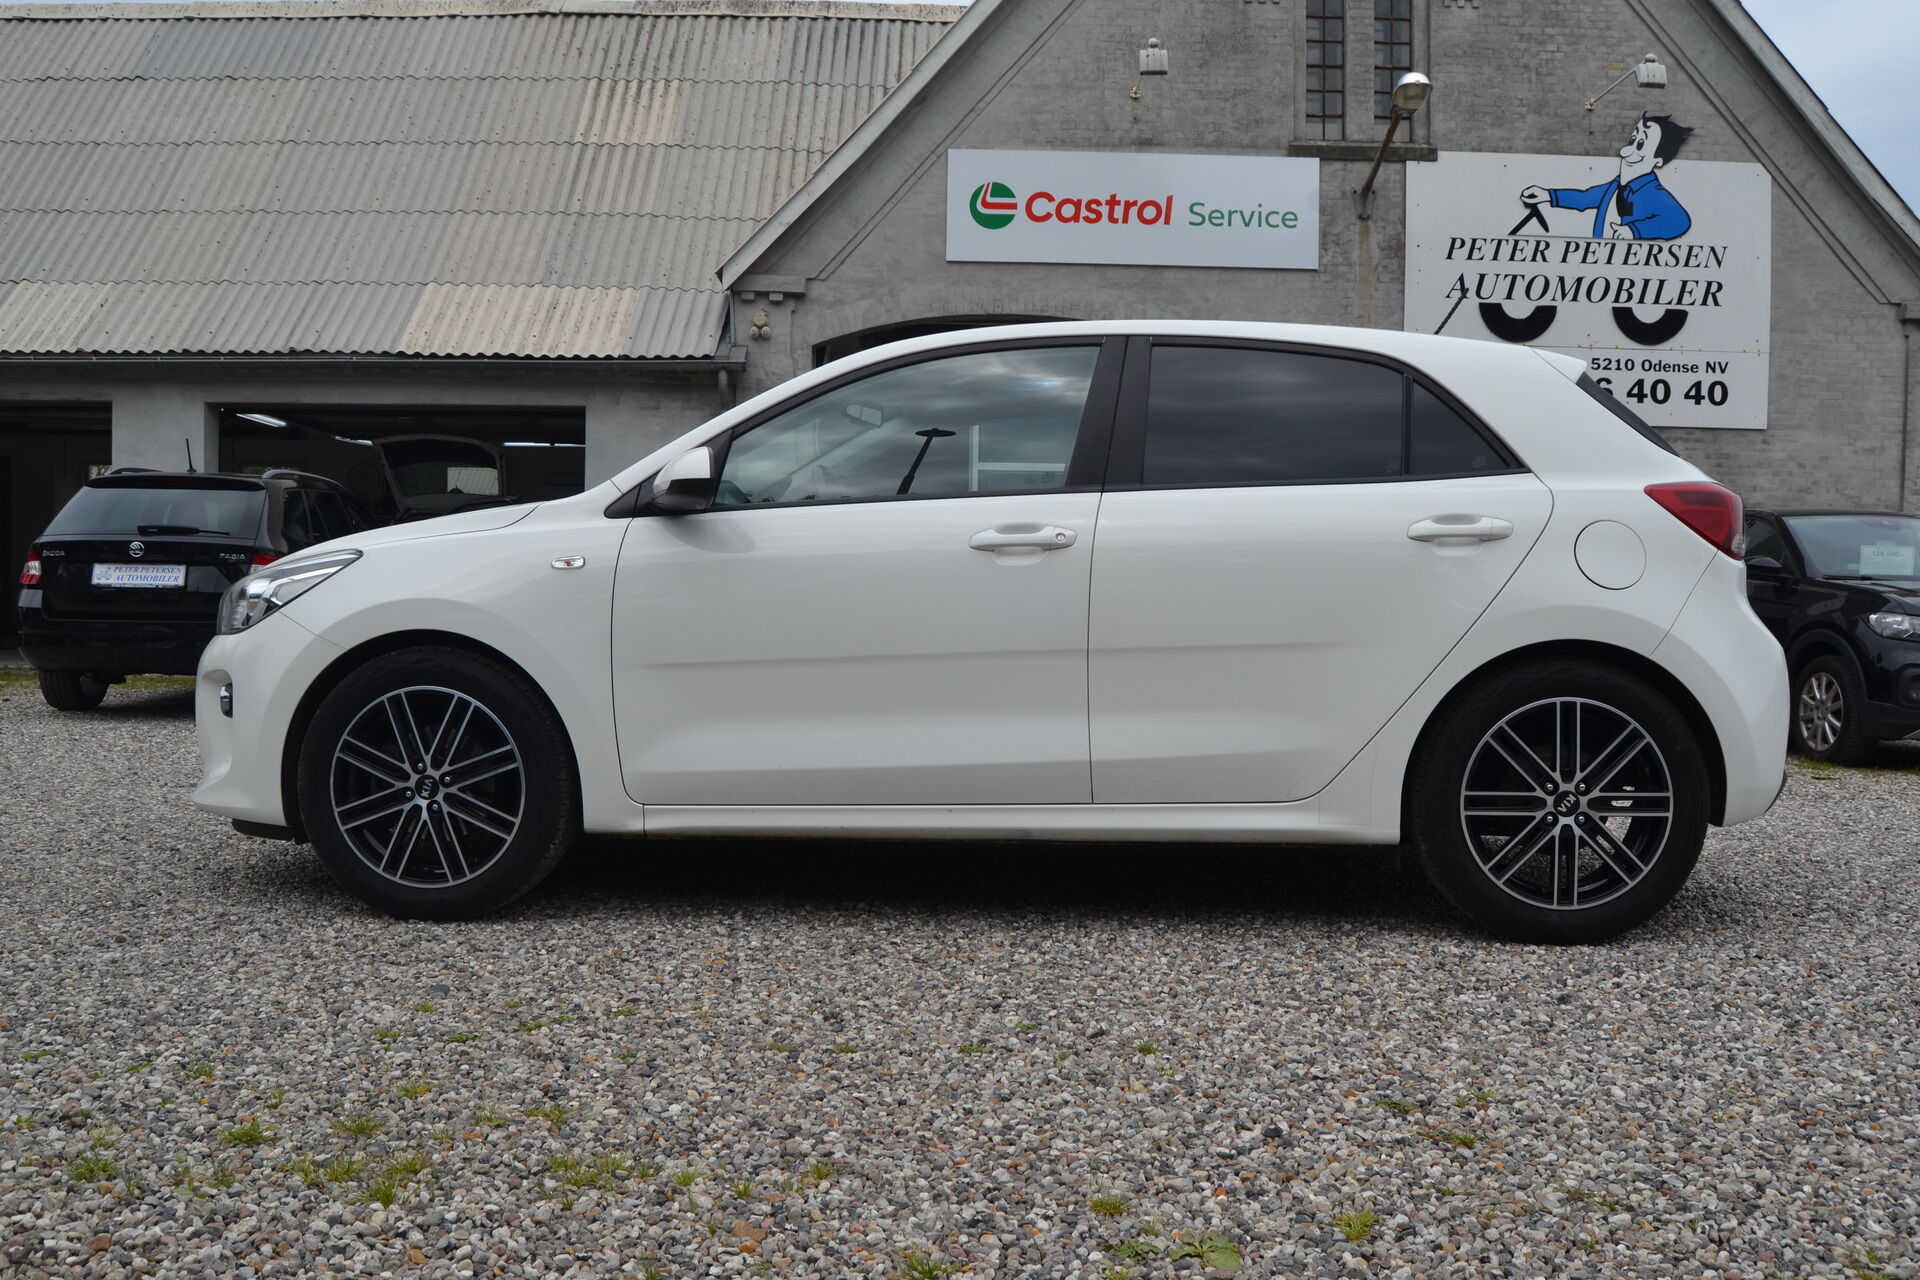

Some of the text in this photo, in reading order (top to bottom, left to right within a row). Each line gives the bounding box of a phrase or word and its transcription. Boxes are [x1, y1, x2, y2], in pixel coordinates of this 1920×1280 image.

[1025, 191, 1298, 228] Castrol Service
[1445, 237, 1728, 269] PETER PETERSEN
[1445, 272, 1724, 308] AUTOMOBILER
[1591, 358, 1729, 374] 5210 Odense NV
[1626, 378, 1671, 405] 40
[1684, 380, 1729, 406] 40
[115, 574, 180, 583] AUTOMOBILER
